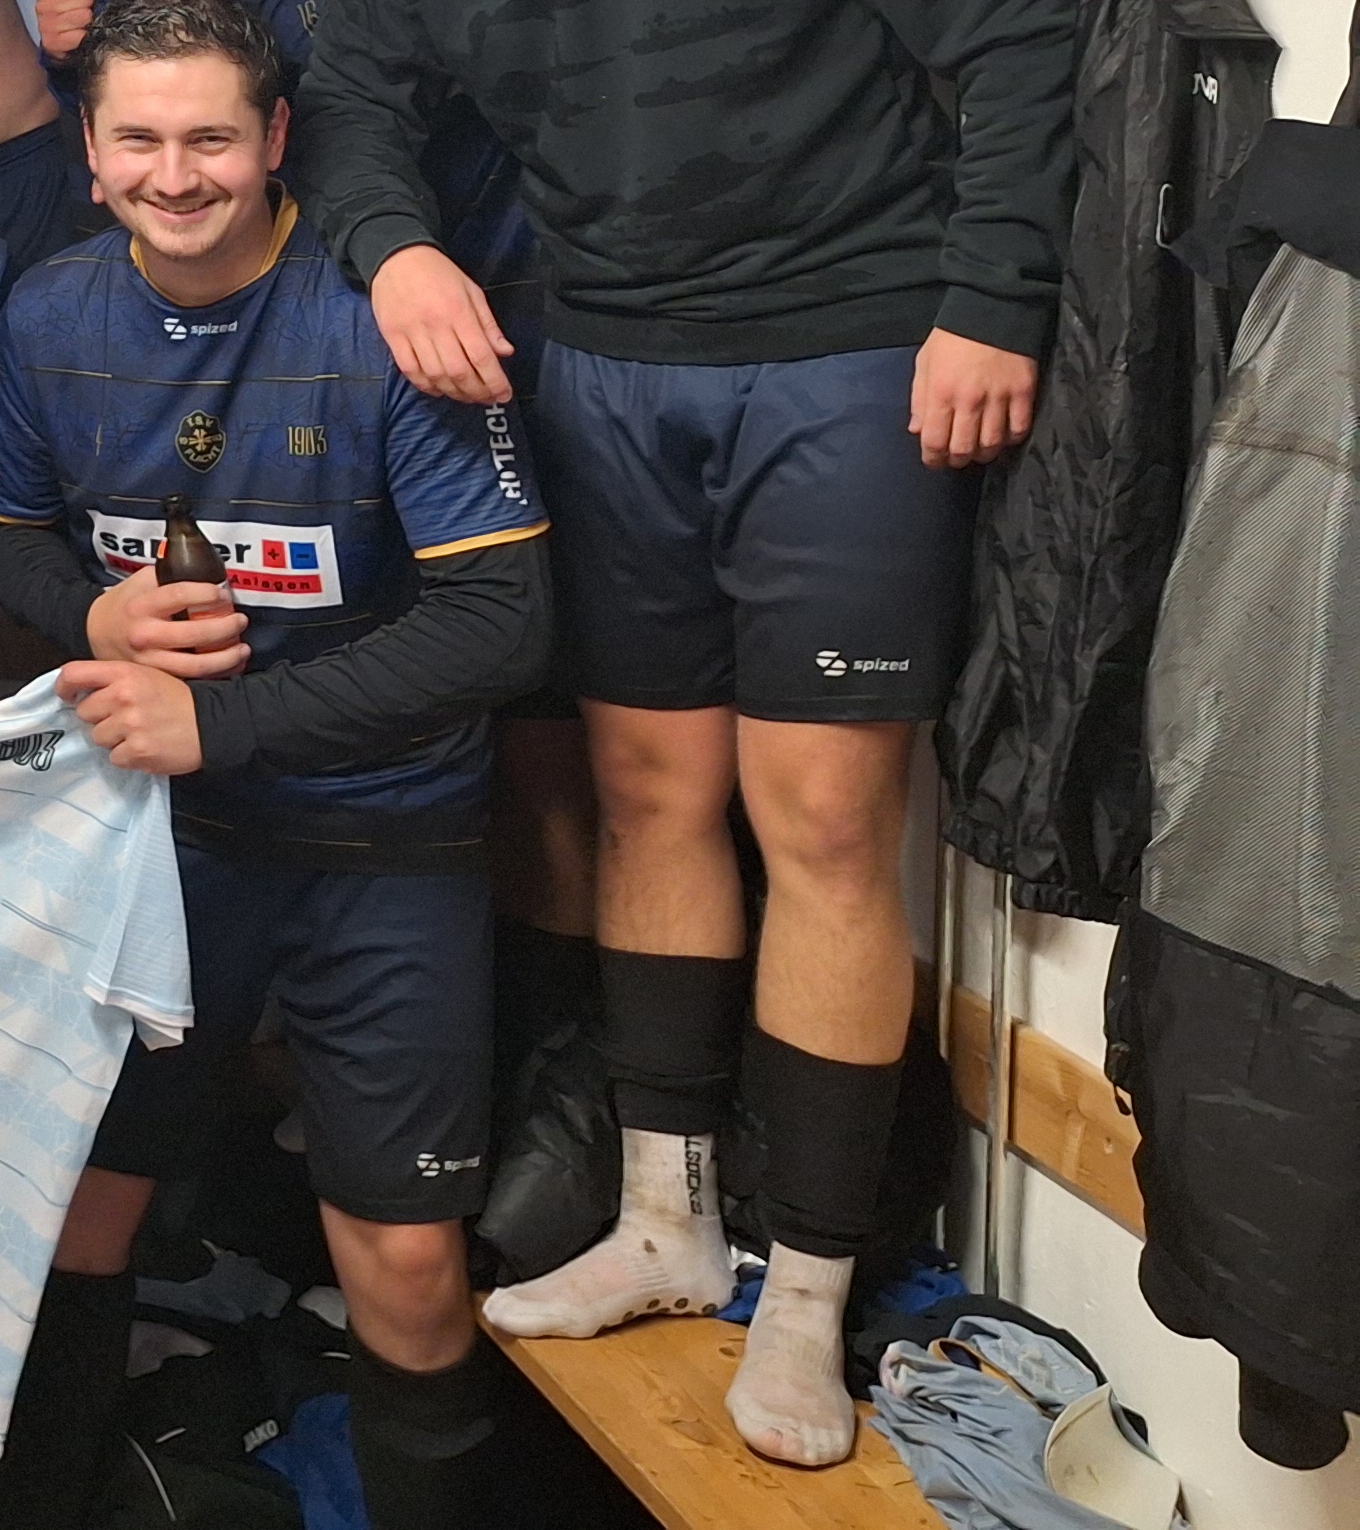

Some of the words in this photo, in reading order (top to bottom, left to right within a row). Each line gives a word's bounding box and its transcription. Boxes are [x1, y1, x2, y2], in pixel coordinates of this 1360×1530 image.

[190, 320, 237, 336] spized
[287, 425, 327, 456] 1903
[99, 531, 251, 564] saer
[230, 575, 312, 592] Anlagen
[853, 657, 910, 673] spized
